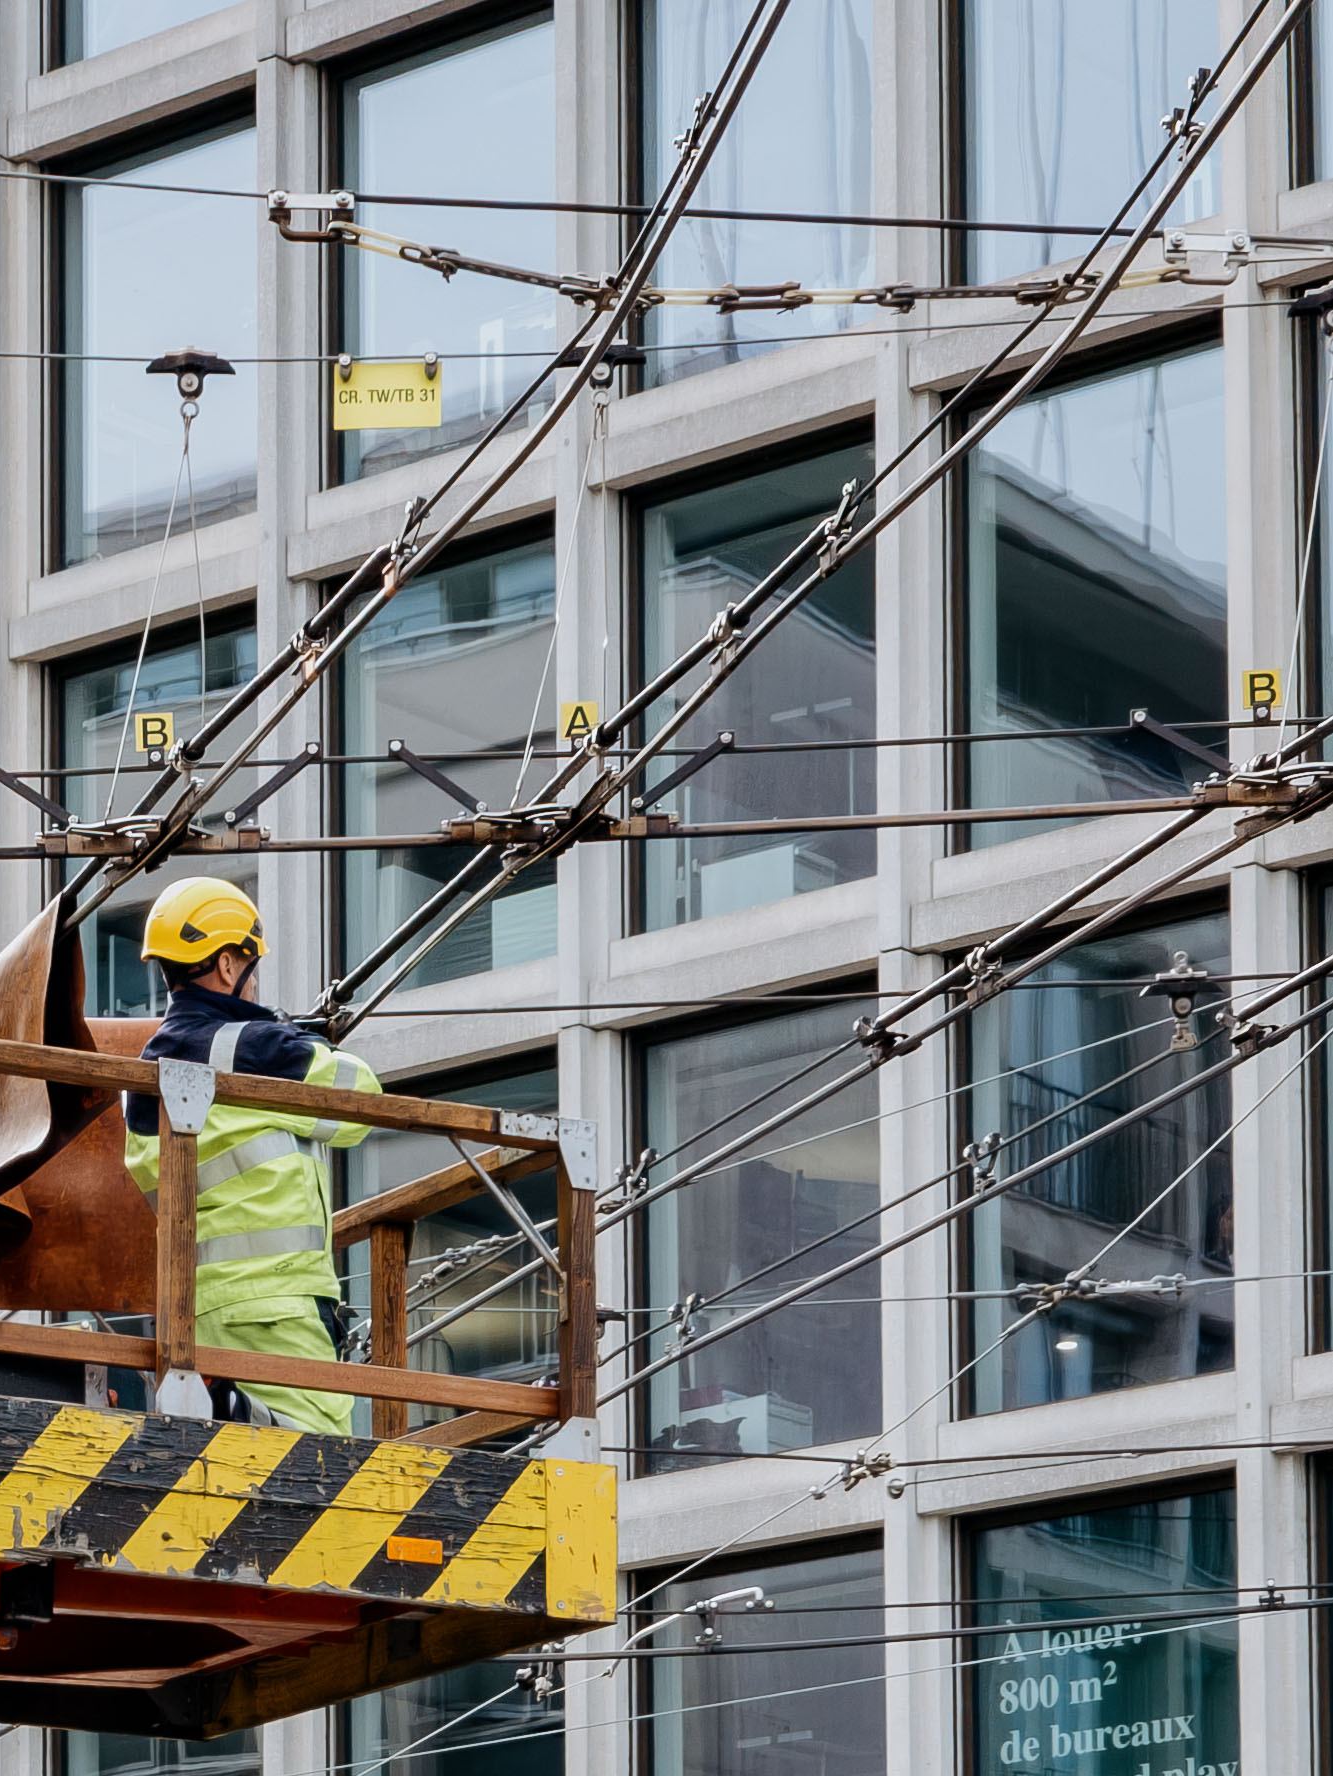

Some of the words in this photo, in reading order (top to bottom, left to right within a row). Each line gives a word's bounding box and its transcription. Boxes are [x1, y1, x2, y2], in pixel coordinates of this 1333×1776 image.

[339, 390, 362, 404] CR.
[368, 388, 414, 403] TW/TB
[420, 388, 436, 402] 31
[1249, 673, 1276, 706] B
[142, 717, 168, 748] B
[564, 705, 592, 738] A
[999, 1674, 1060, 1715] 800
[1000, 1730, 1040, 1764] de
[1050, 1714, 1196, 1758] bureaux
